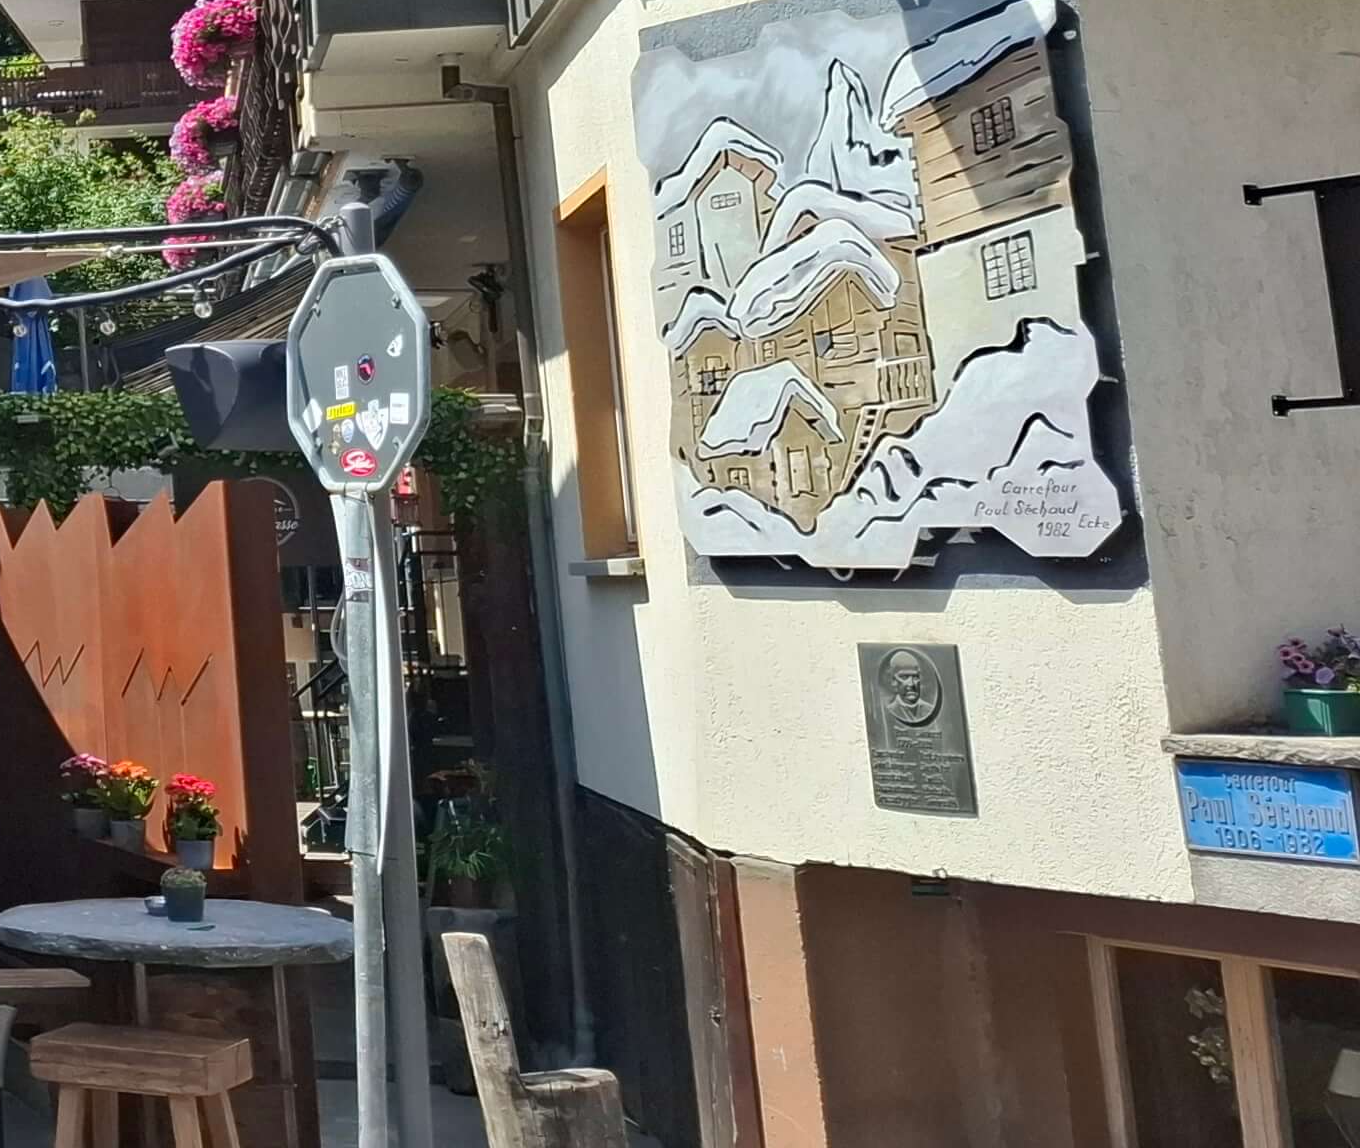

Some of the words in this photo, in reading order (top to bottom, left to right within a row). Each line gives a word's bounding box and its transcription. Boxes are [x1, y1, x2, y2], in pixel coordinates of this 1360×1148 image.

[1001, 478, 1078, 498] Carrefour
[974, 501, 1009, 517] Paul
[1037, 521, 1071, 537] 1982
[1183, 787, 1236, 825] Paul
[1248, 792, 1350, 835] Séchaud
